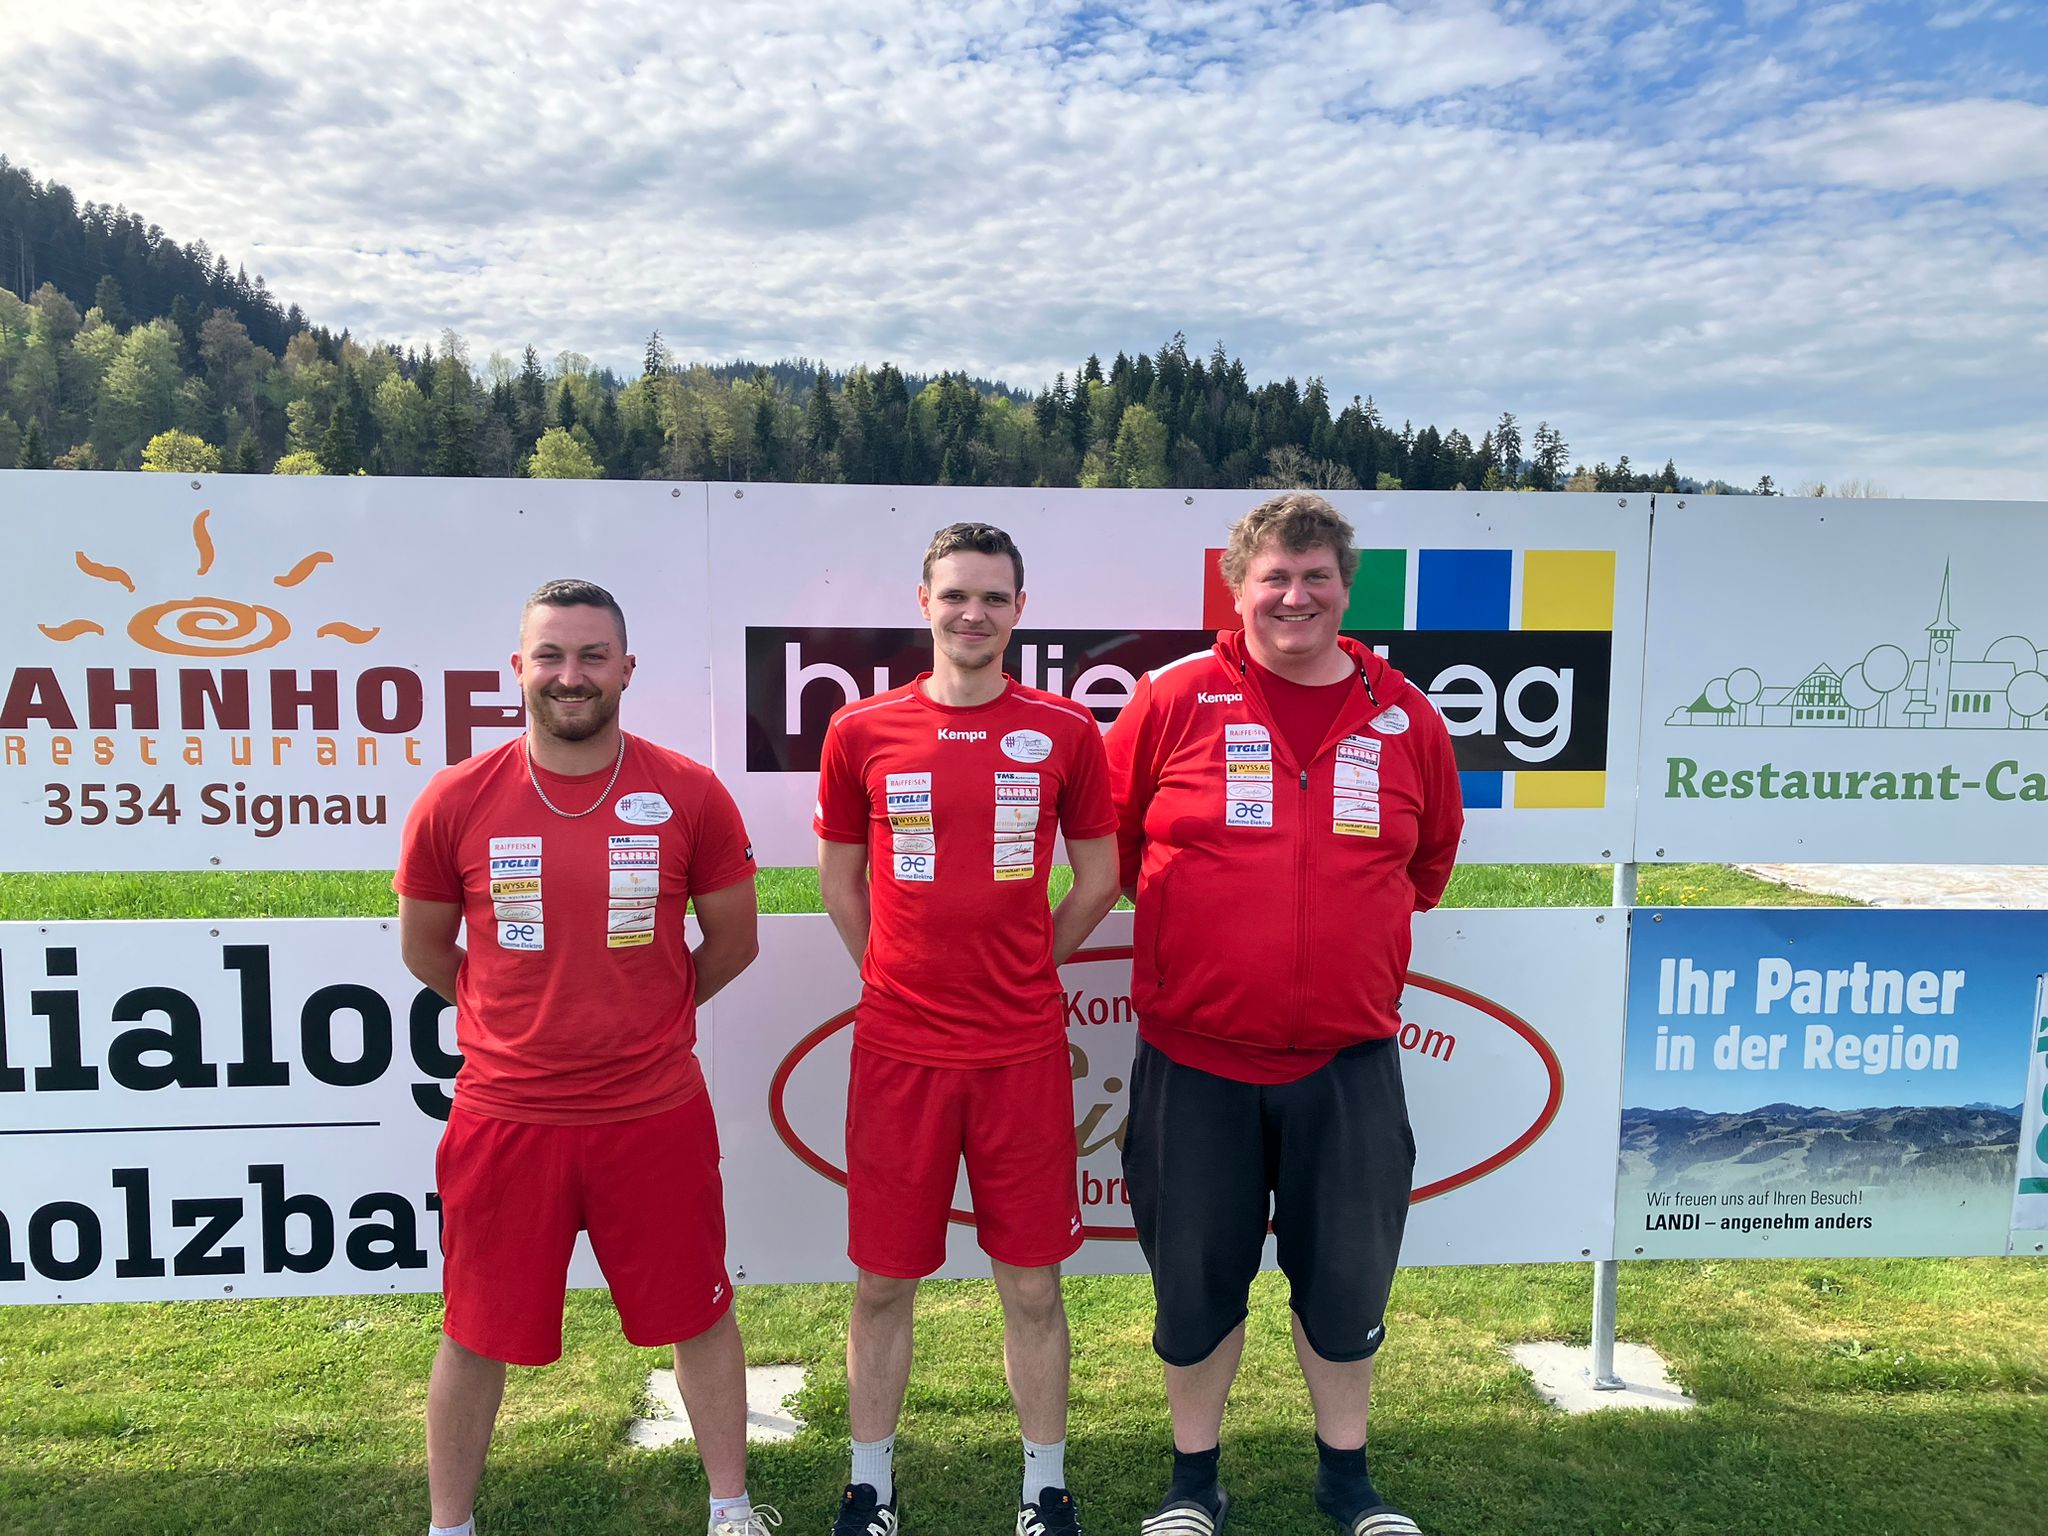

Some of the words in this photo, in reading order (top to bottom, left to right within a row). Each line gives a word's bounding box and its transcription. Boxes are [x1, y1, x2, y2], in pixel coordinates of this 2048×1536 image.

[1197, 692, 1243, 704] Kempa
[1427, 664, 1574, 763] ag
[937, 728, 987, 743] Kempa
[5, 735, 421, 765] Restaurant
[1339, 747, 1378, 761] GERBER
[890, 778, 927, 786] RAIFFEISEN
[1664, 756, 2048, 801] Restaurant-Ca
[998, 788, 1038, 797] GERBER
[44, 782, 182, 826] 3534
[200, 781, 387, 838] Signau
[612, 851, 657, 861] GERBER
[502, 882, 525, 890] WYSS
[1658, 957, 1736, 1015] Ihr
[1755, 957, 1965, 1015] Partner
[0, 944, 464, 1122] ialog
[1655, 1025, 1696, 1071] in
[1713, 1024, 1787, 1070] der
[1803, 1024, 1959, 1075] Region
[1646, 1191, 1672, 1207] Wir
[1675, 1191, 1717, 1207] freuen
[1721, 1193, 1744, 1206] uns
[1748, 1191, 1770, 1206] auf
[1773, 1191, 1806, 1206] Ihren
[1811, 1190, 1863, 1205] Besuch!
[0, 1163, 446, 1278] olzba
[1646, 1213, 1700, 1231] LANDI
[1720, 1213, 1809, 1233] angenehm
[1814, 1212, 1873, 1229] anders
